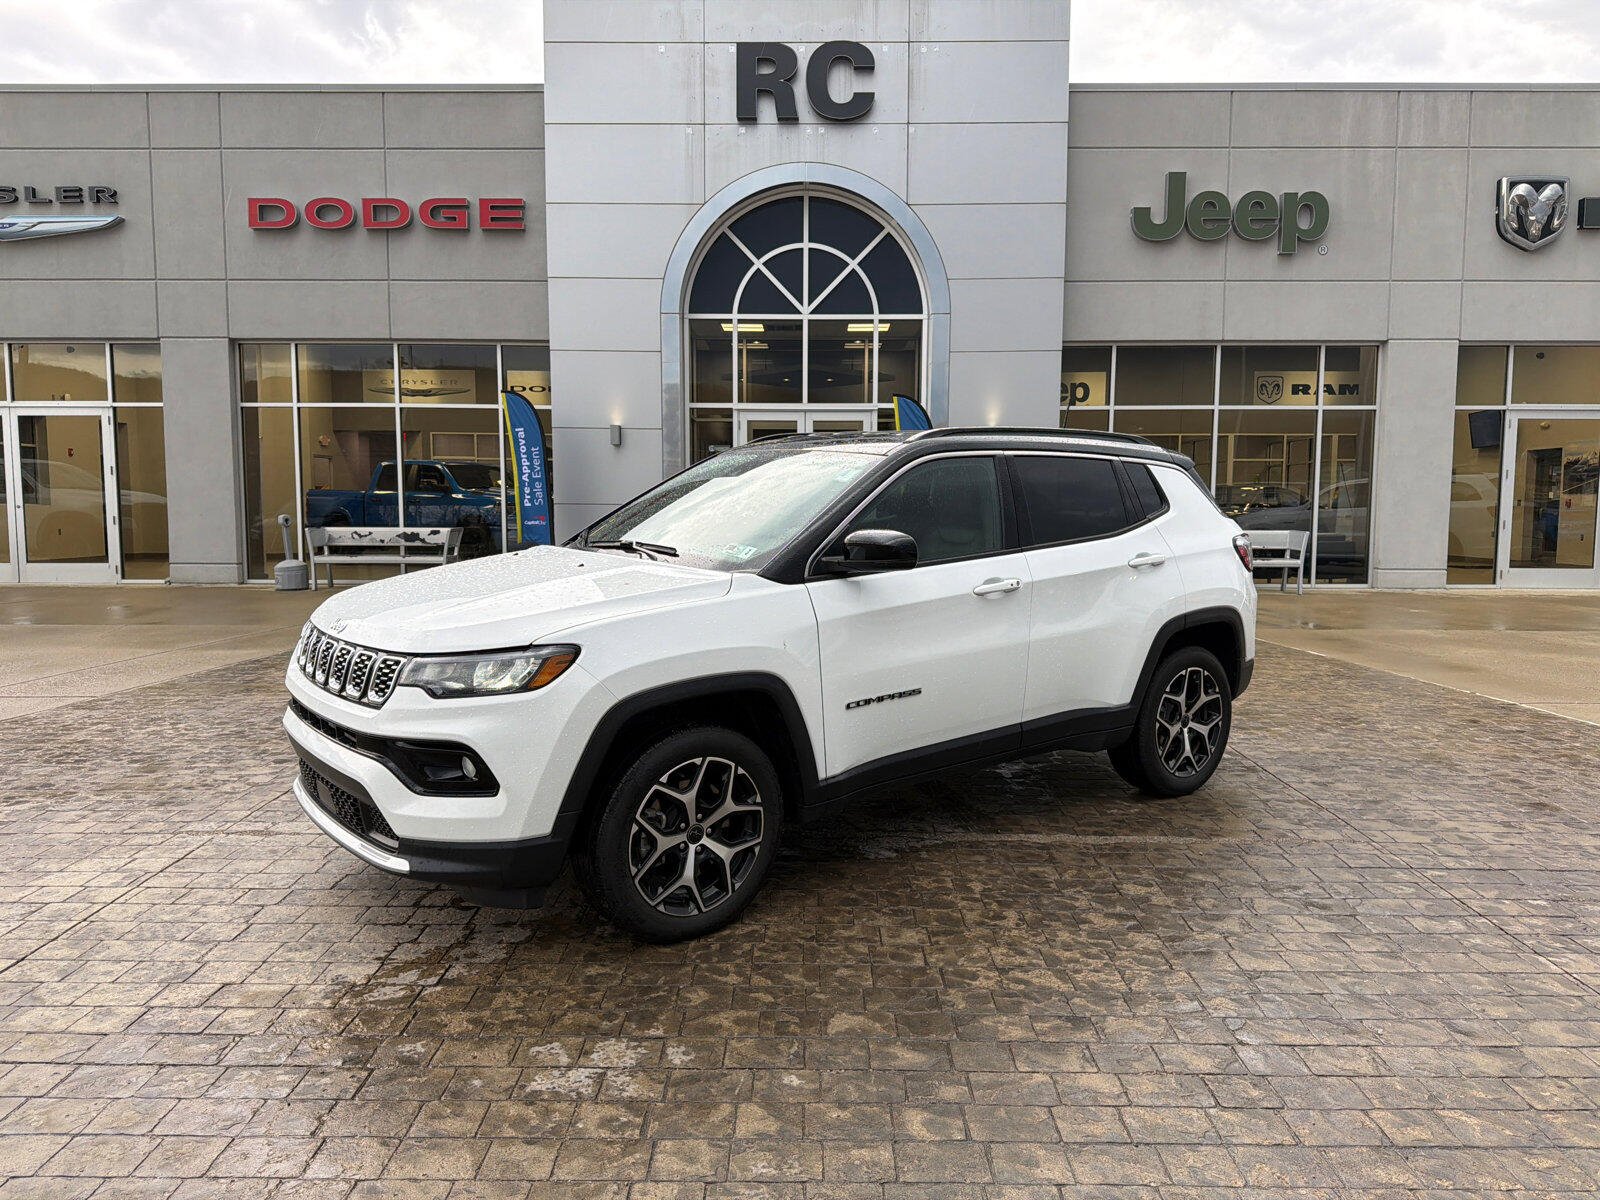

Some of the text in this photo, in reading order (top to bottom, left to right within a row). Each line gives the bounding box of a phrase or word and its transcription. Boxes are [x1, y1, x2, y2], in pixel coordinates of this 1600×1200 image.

[736, 40, 875, 121] RC
[247, 197, 526, 230] DODGE
[1131, 171, 1330, 255] Jeep
[515, 428, 532, 507] Pre-Approval
[531, 446, 544, 506] Sale Event
[845, 687, 922, 710] COMPASS
